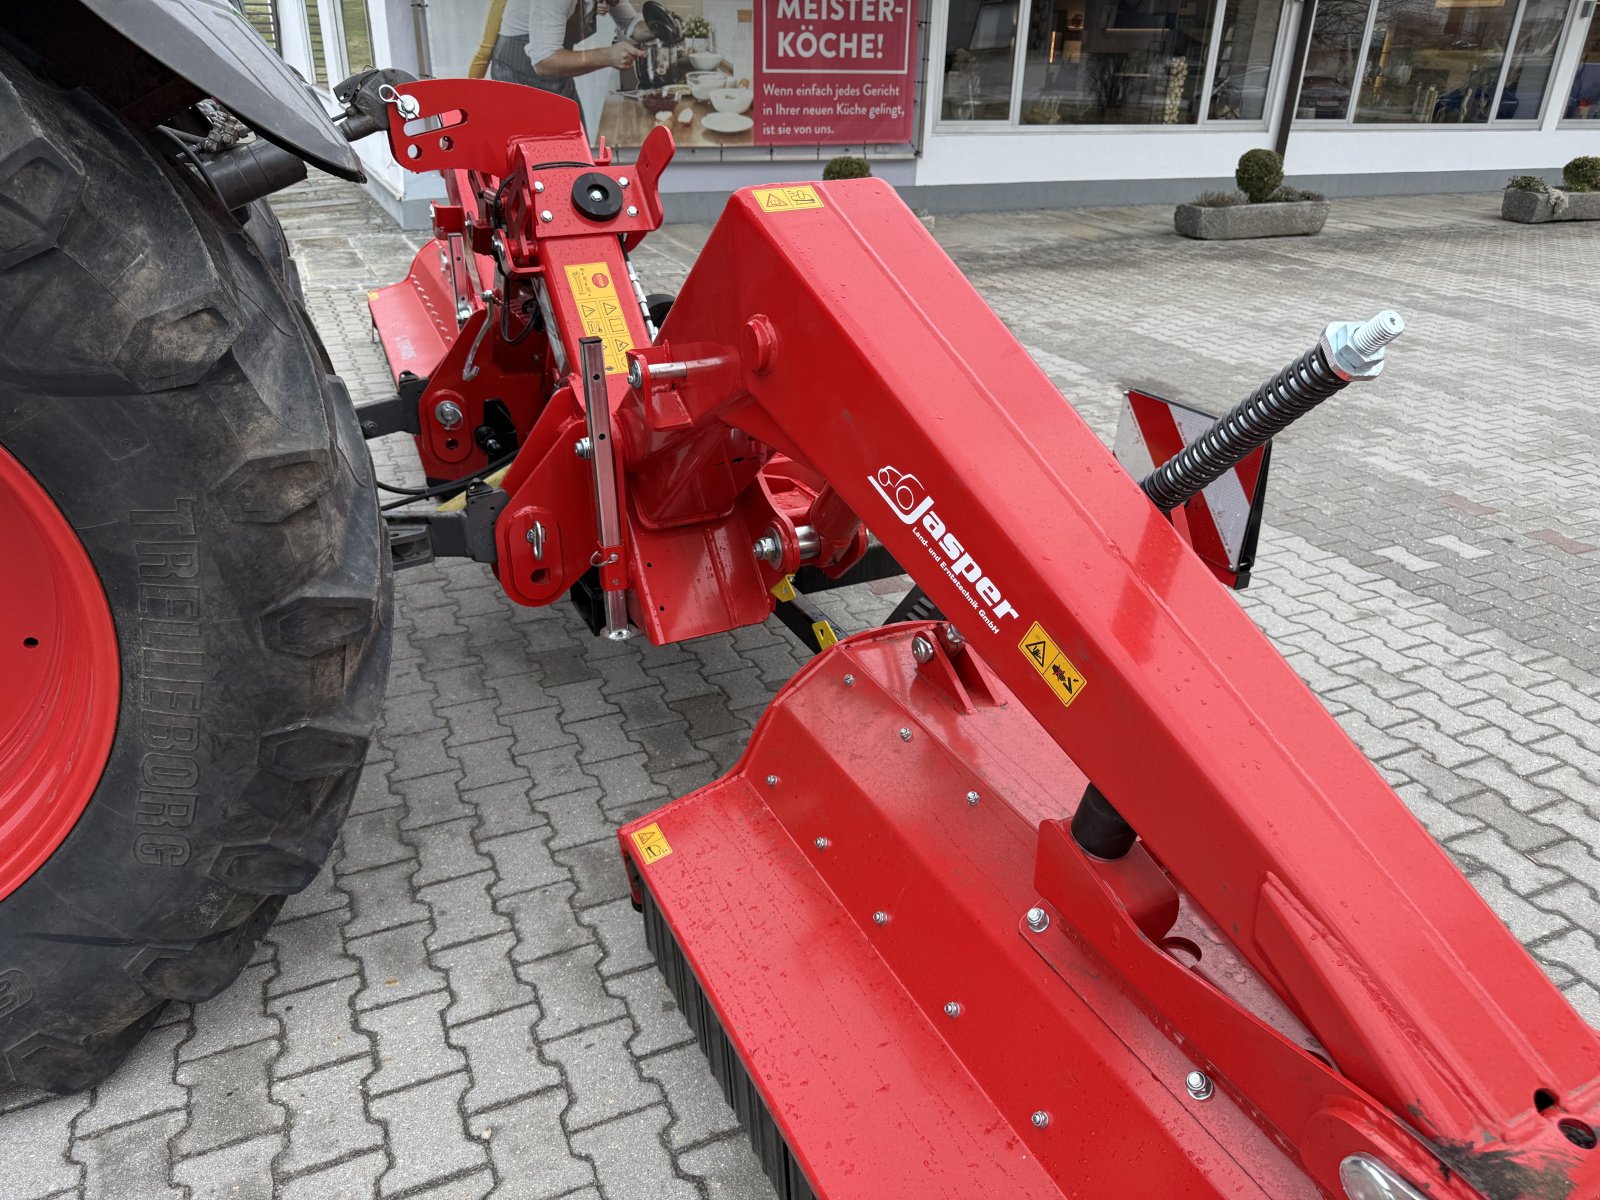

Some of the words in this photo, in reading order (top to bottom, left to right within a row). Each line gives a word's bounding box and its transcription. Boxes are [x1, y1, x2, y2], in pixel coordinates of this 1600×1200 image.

[777, 0, 904, 22] MEISTER-
[777, 24, 884, 59] KÖCHE!
[763, 83, 793, 96] Wenn
[796, 84, 833, 97] einfach
[833, 84, 861, 100] jedes
[863, 84, 900, 97] Gericht
[763, 103, 773, 116] in
[775, 103, 801, 116] Ihrer
[803, 104, 834, 117] neuen
[836, 102, 867, 116] Küche
[869, 103, 905, 119] gelingt,
[763, 123, 775, 135] ist
[777, 122, 792, 135] sie
[794, 125, 812, 135] von
[814, 124, 834, 135] uns.
[867, 475, 1019, 619] Jasper
[912, 526, 929, 547] Land-
[928, 547, 942, 562] und
[939, 561, 979, 610] Erntetechnik
[978, 609, 1000, 635] GmbH
[129, 497, 201, 868] TRELLEBORG
